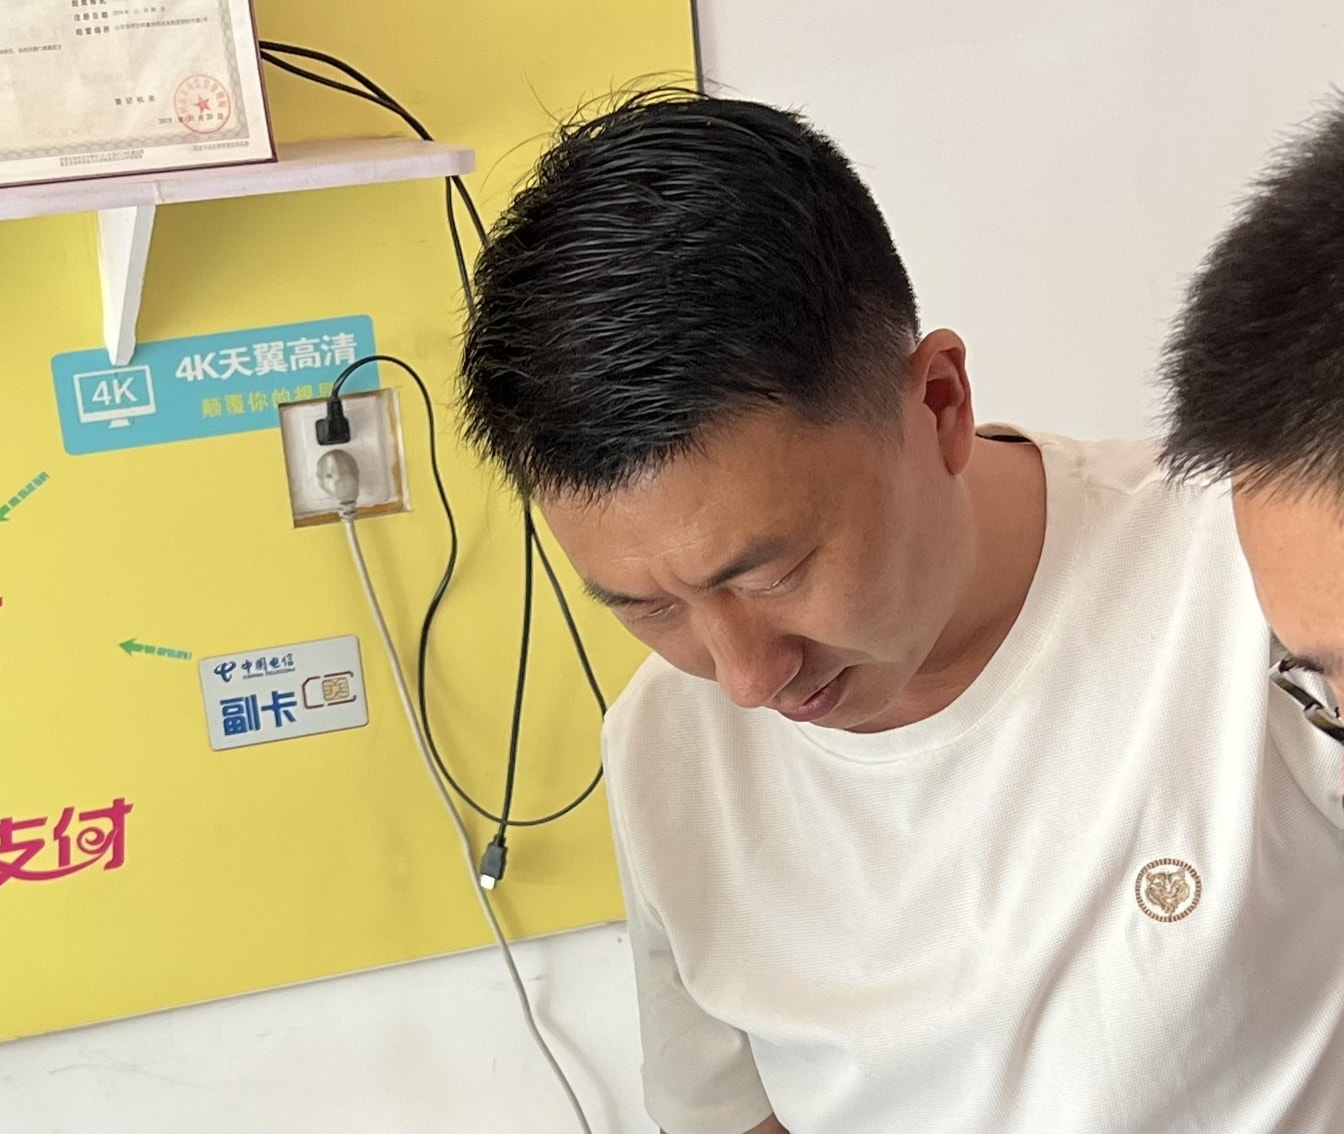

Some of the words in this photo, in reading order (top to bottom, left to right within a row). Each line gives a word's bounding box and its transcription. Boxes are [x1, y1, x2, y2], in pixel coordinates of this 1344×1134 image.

[175, 333, 358, 382] 4K天翼高清
[92, 378, 138, 406] 4K
[241, 653, 295, 675] 中国电信
[220, 691, 298, 736] 副卡
